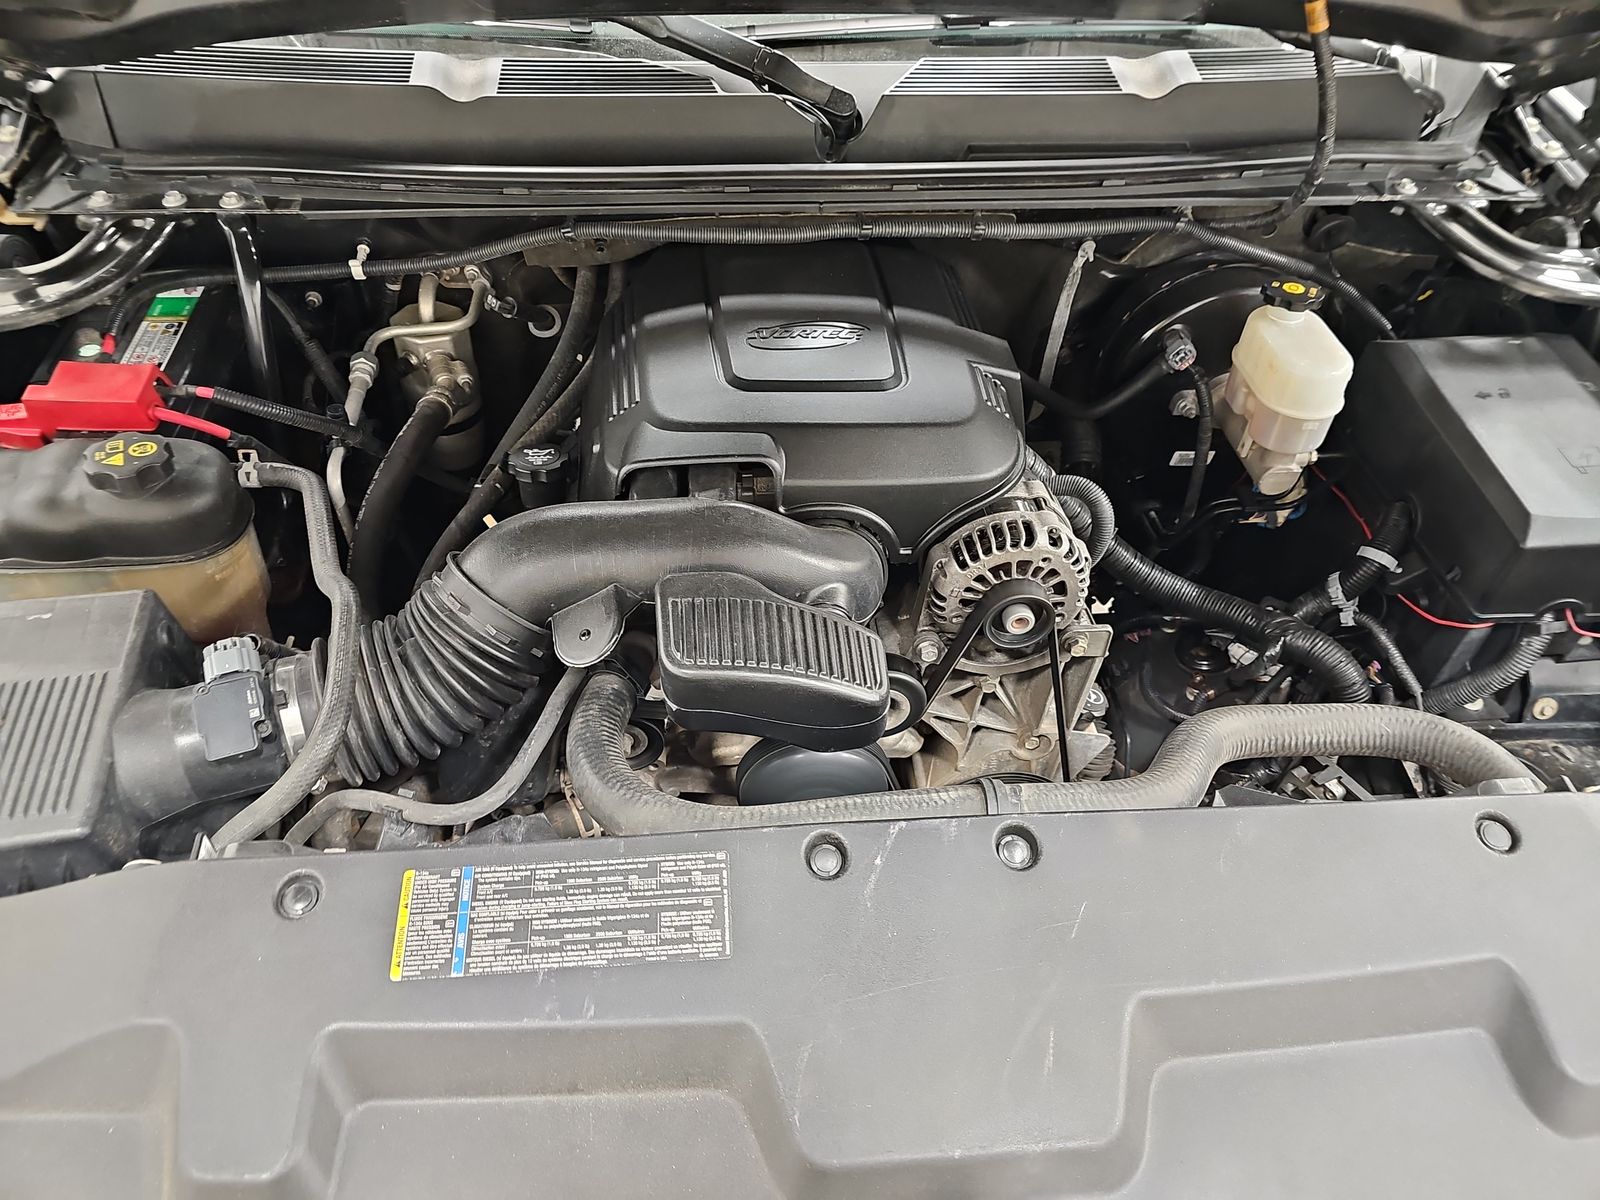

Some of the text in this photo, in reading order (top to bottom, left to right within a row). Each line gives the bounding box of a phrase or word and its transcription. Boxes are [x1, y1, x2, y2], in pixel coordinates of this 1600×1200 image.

[755, 327, 861, 341] VORTEC
[403, 876, 412, 902] CAUTION
[462, 878, 471, 902] NOTICE
[395, 926, 406, 959] ATTENTION
[457, 932, 465, 948] AVIS
